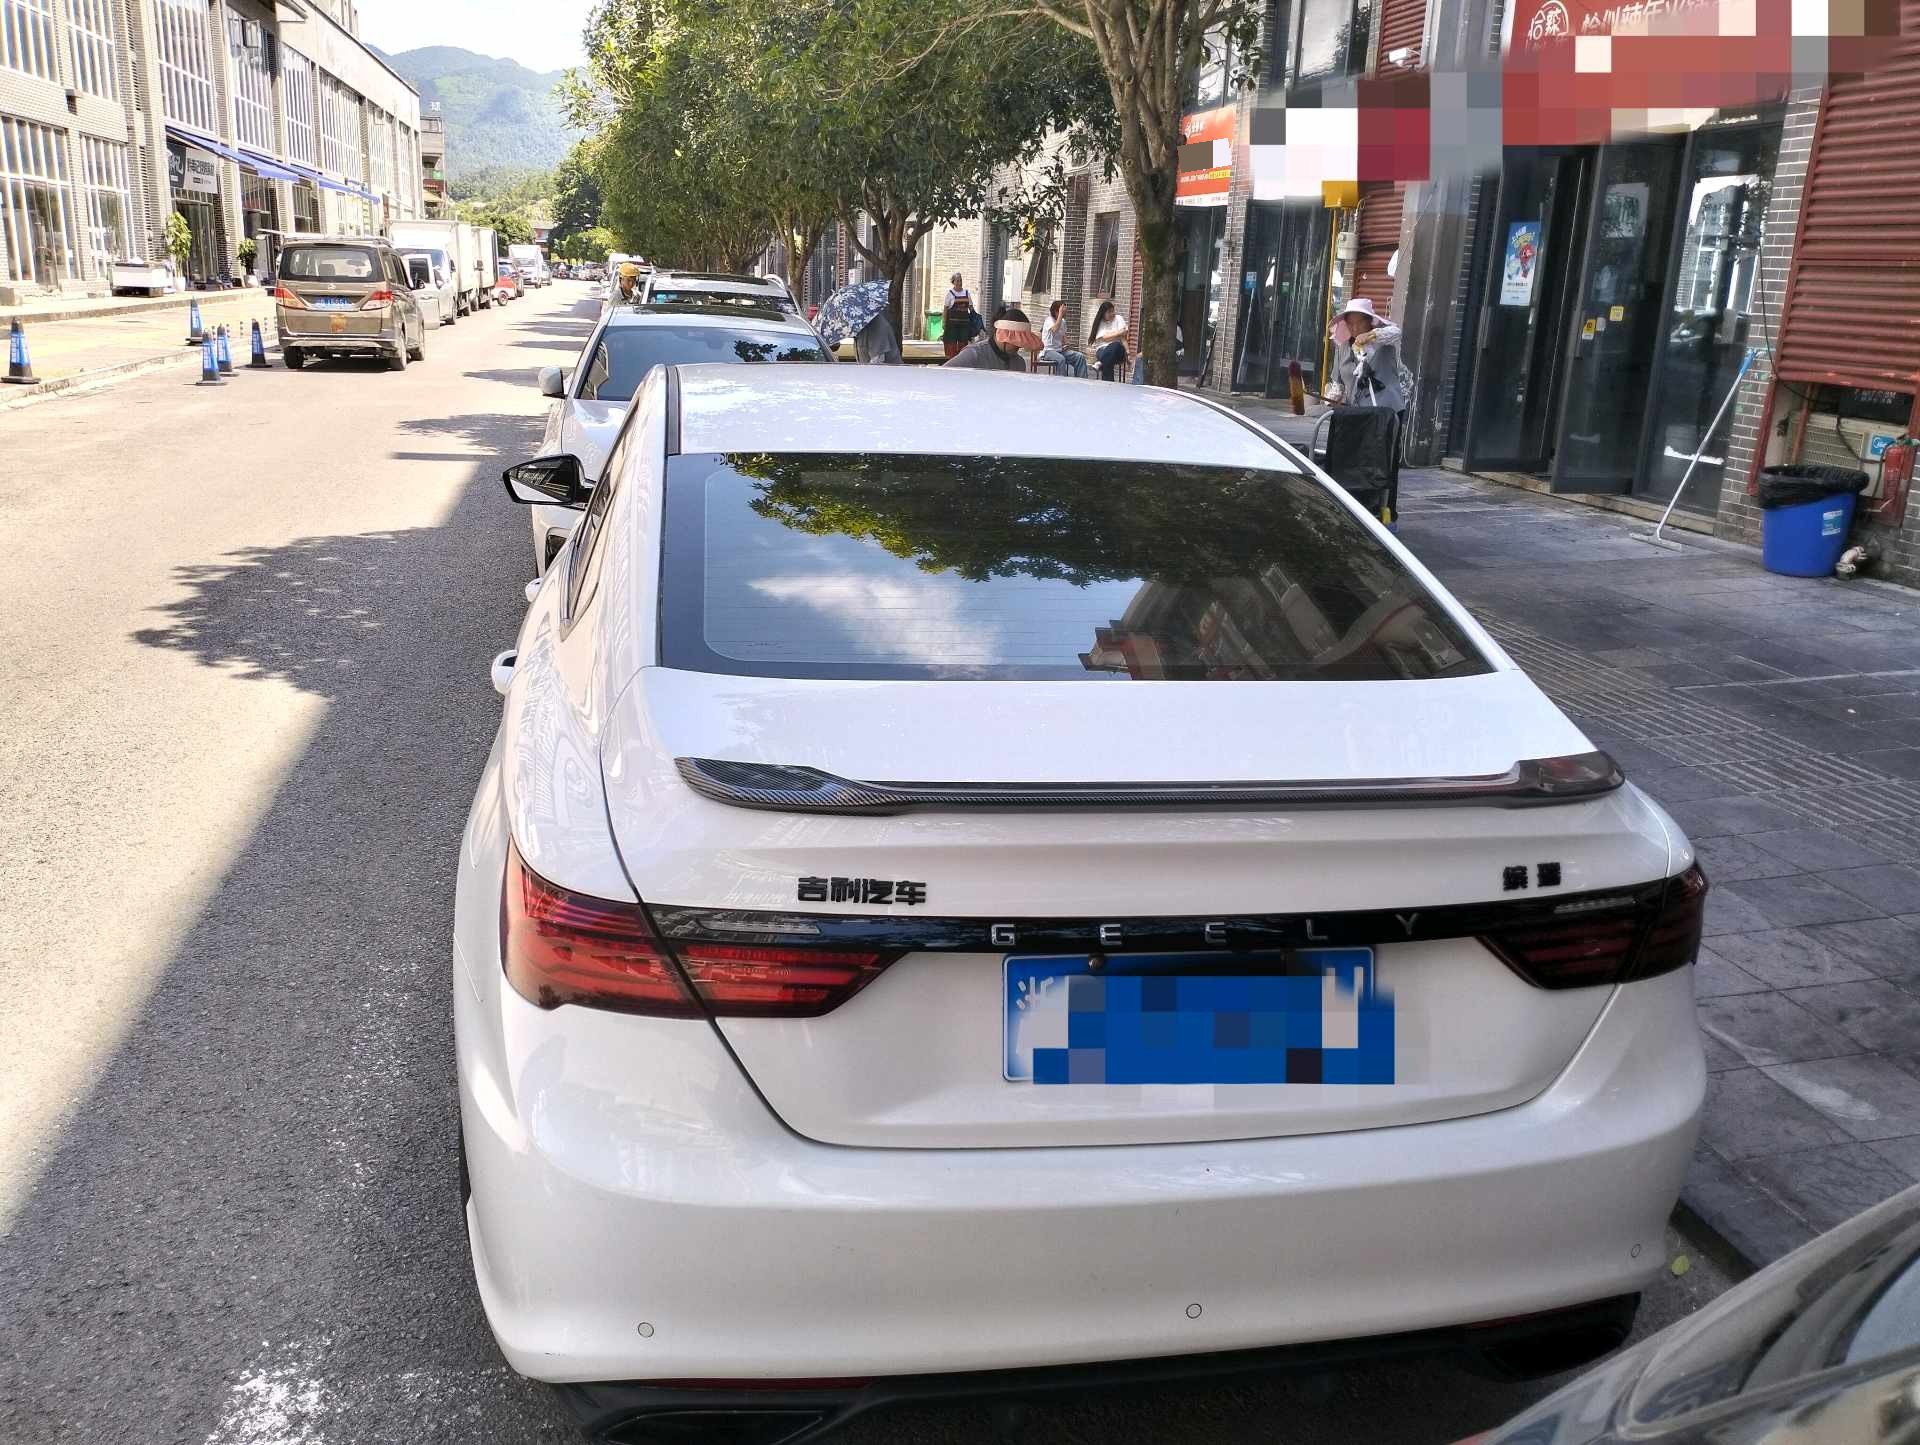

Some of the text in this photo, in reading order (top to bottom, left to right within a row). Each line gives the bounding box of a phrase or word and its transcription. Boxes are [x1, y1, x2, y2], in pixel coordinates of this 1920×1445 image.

[797, 876, 927, 906] 吉利汽车
[990, 912, 1420, 947] GEELY
